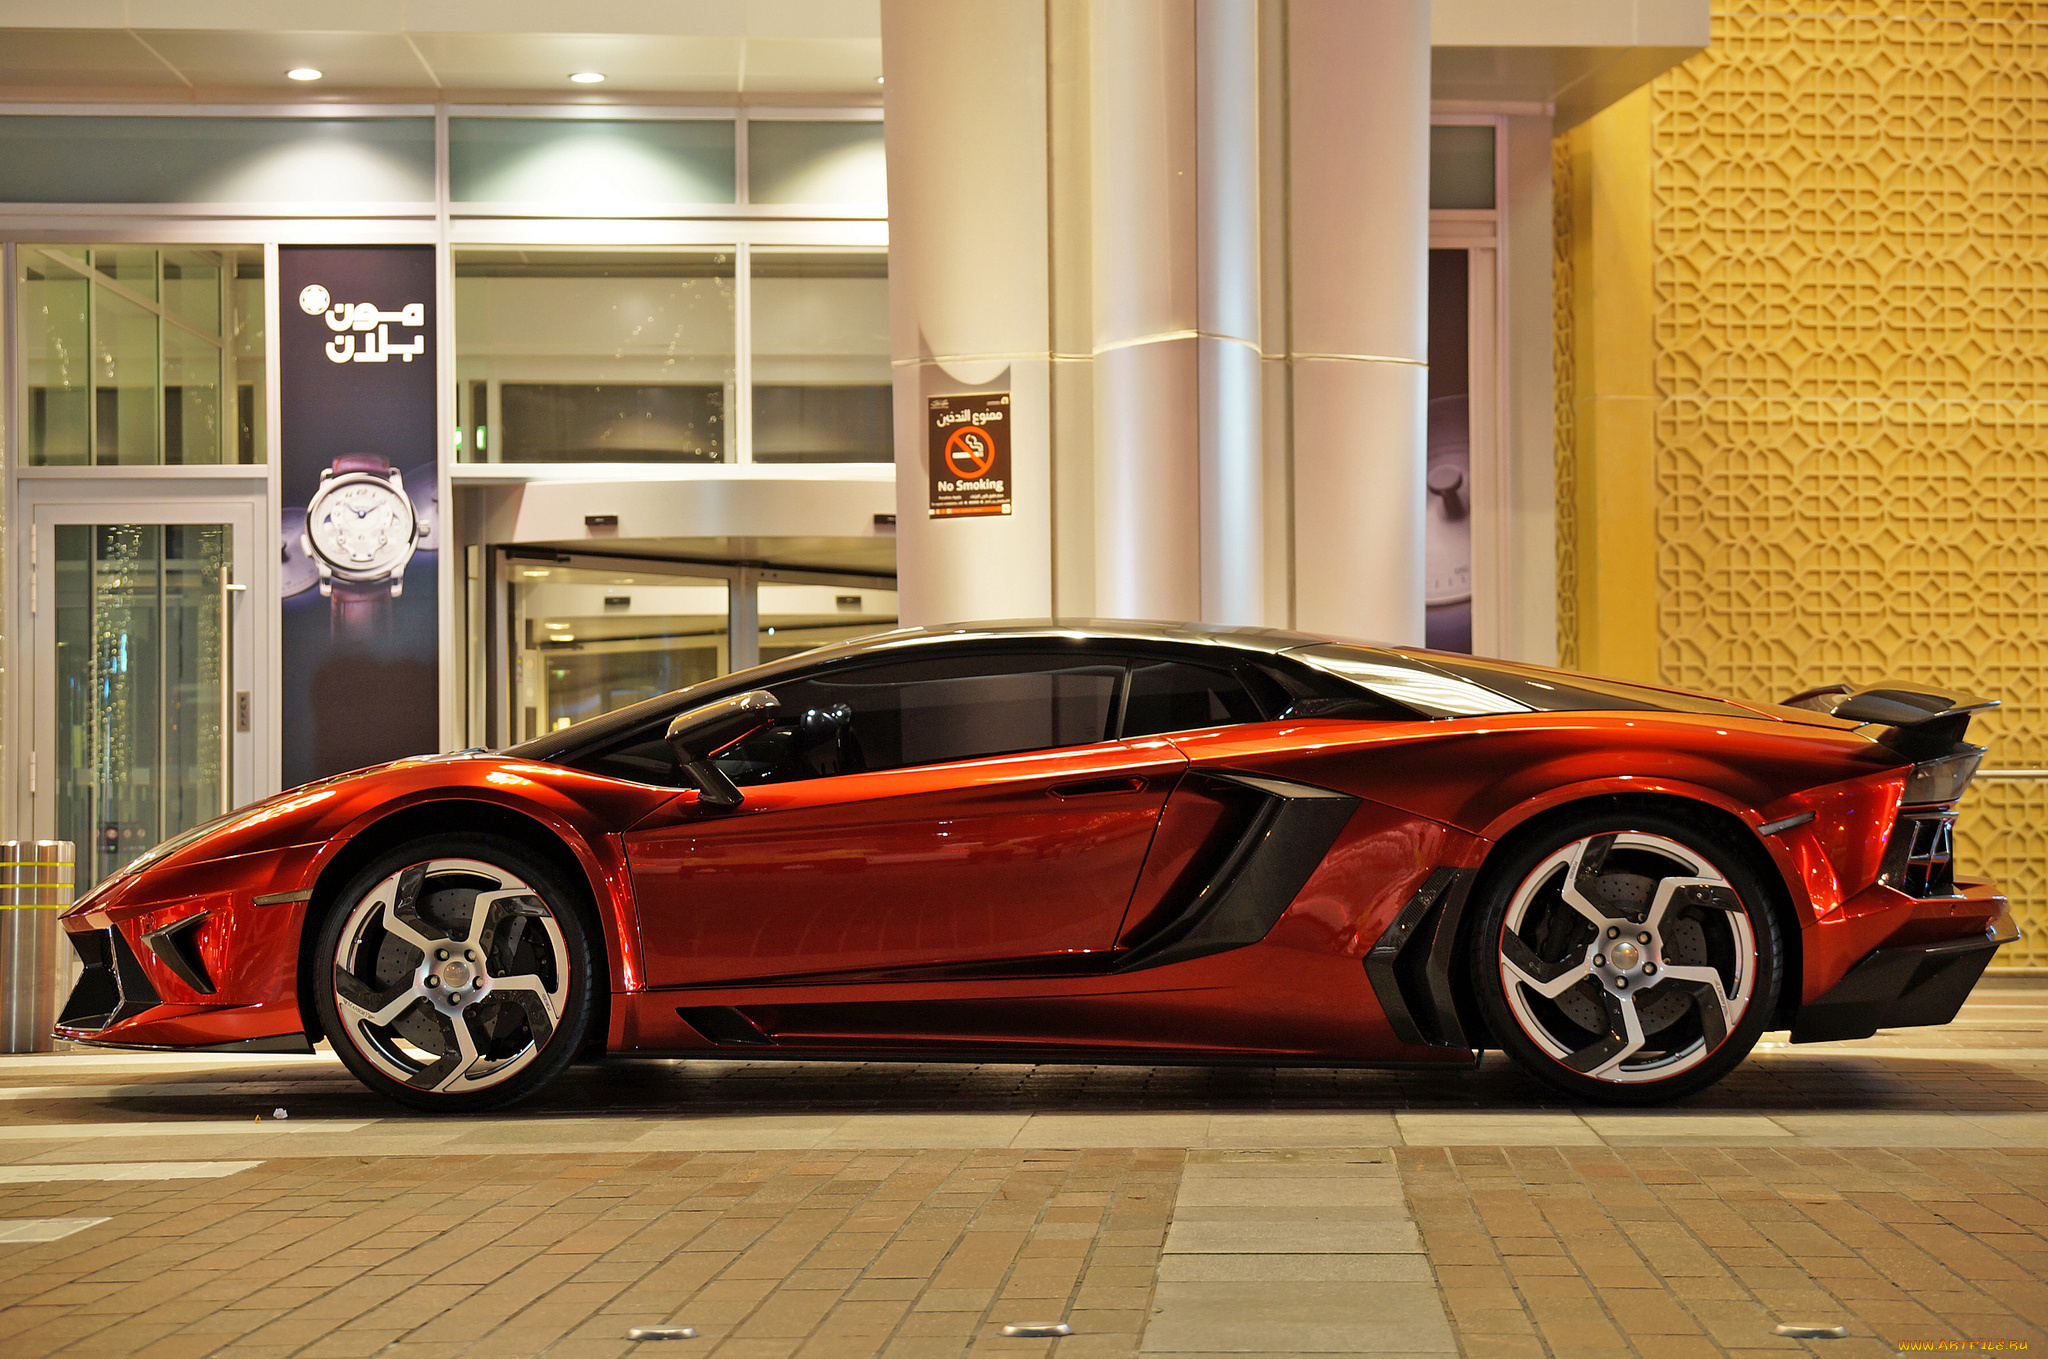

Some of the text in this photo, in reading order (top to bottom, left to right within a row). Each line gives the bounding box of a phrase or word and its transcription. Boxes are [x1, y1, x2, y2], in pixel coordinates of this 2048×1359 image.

[936, 408, 1003, 428] ممنوع التدخين
[938, 479, 1004, 493] No Smoking
